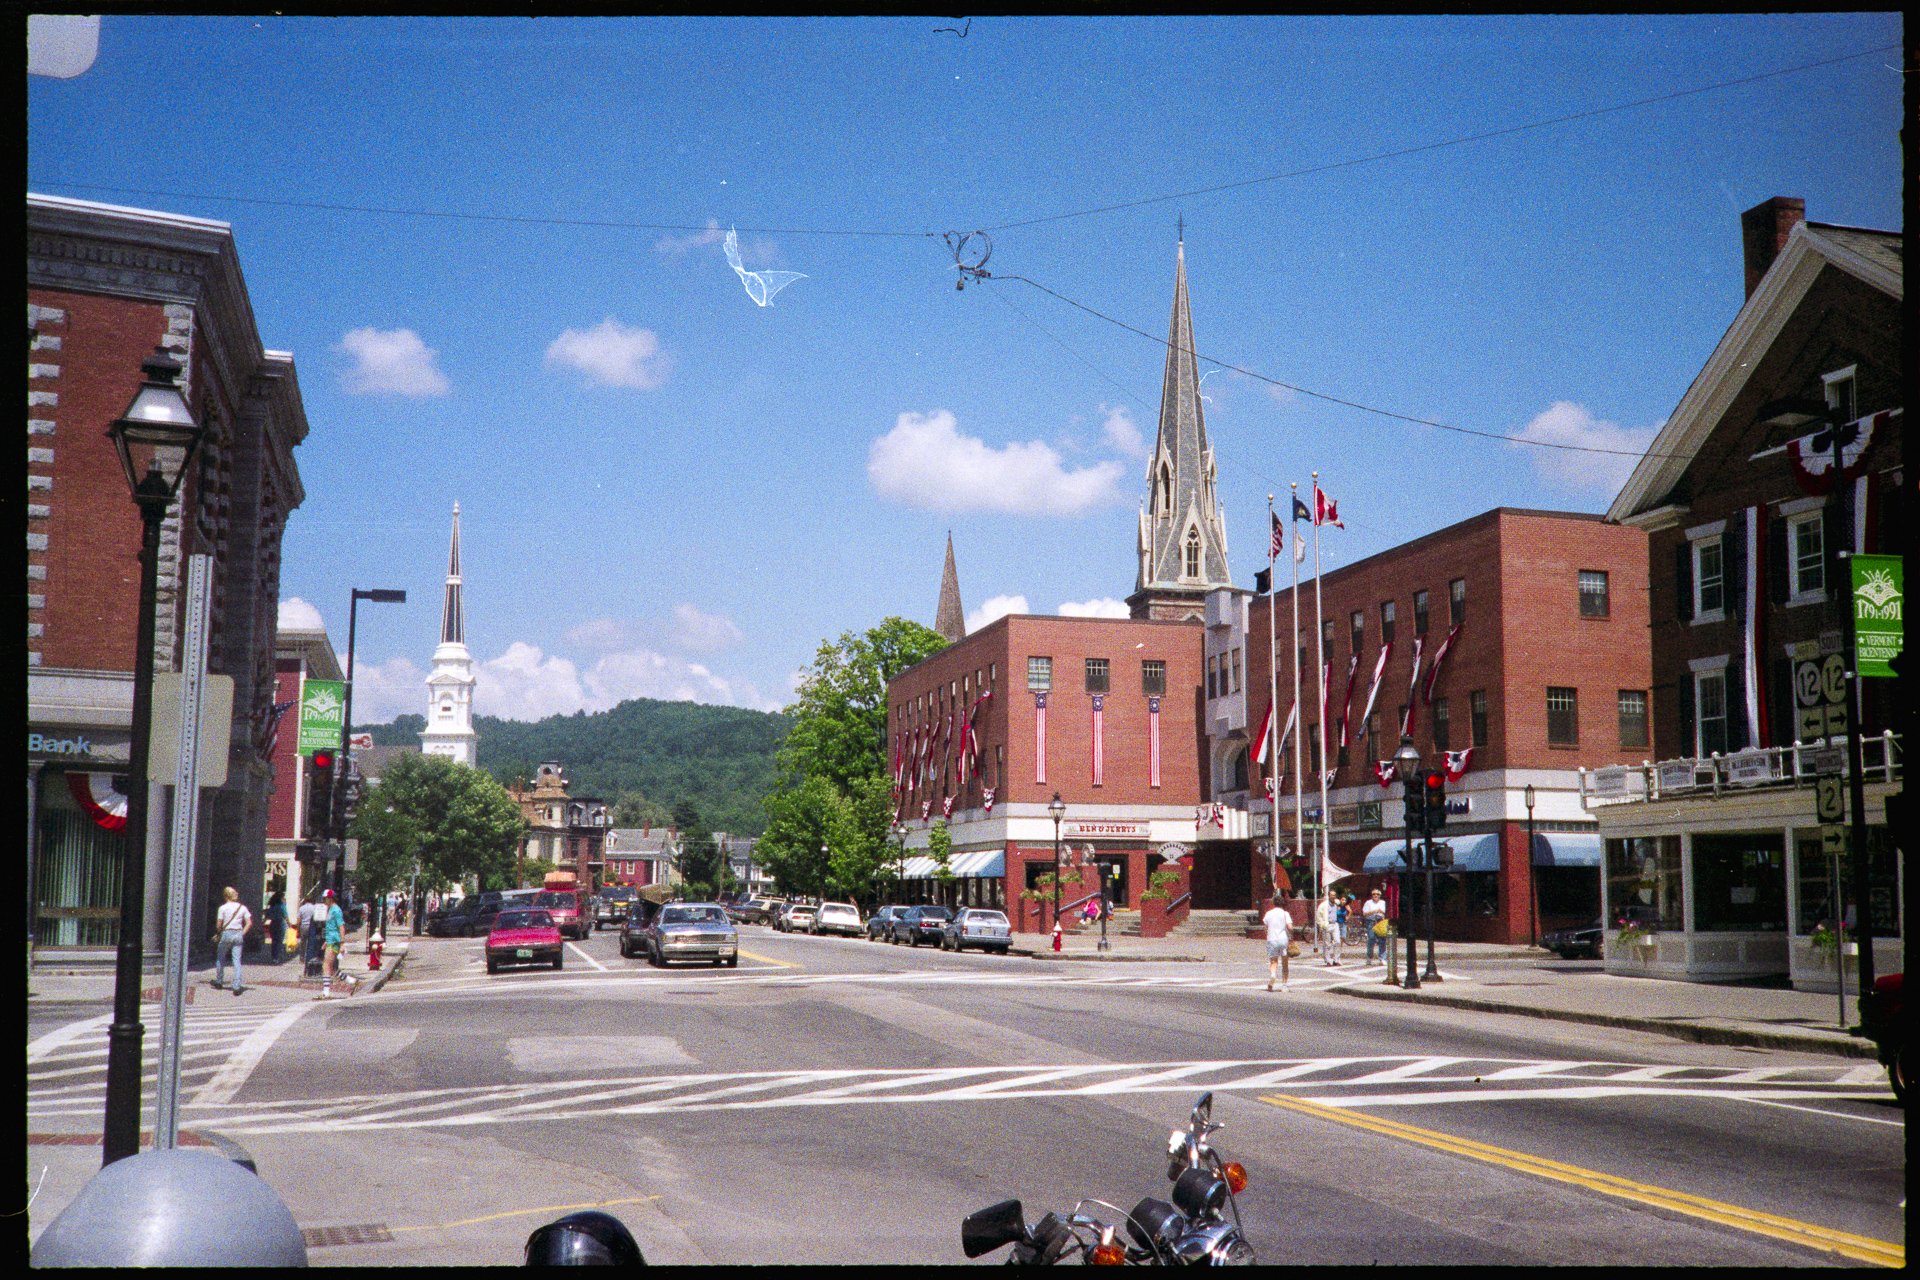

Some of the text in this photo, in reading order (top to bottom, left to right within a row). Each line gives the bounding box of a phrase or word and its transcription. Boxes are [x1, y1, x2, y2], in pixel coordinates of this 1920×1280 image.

[1857, 599, 1902, 620] 1791-1991
[1866, 635, 1896, 646] VERMONT
[1859, 647, 1903, 658] BICENTENN
[1800, 671, 1818, 696] 12
[1825, 664, 1844, 691] 12
[28, 733, 90, 754] Bank
[1825, 786, 1836, 811] 2
[1079, 825, 1096, 833] BEN
